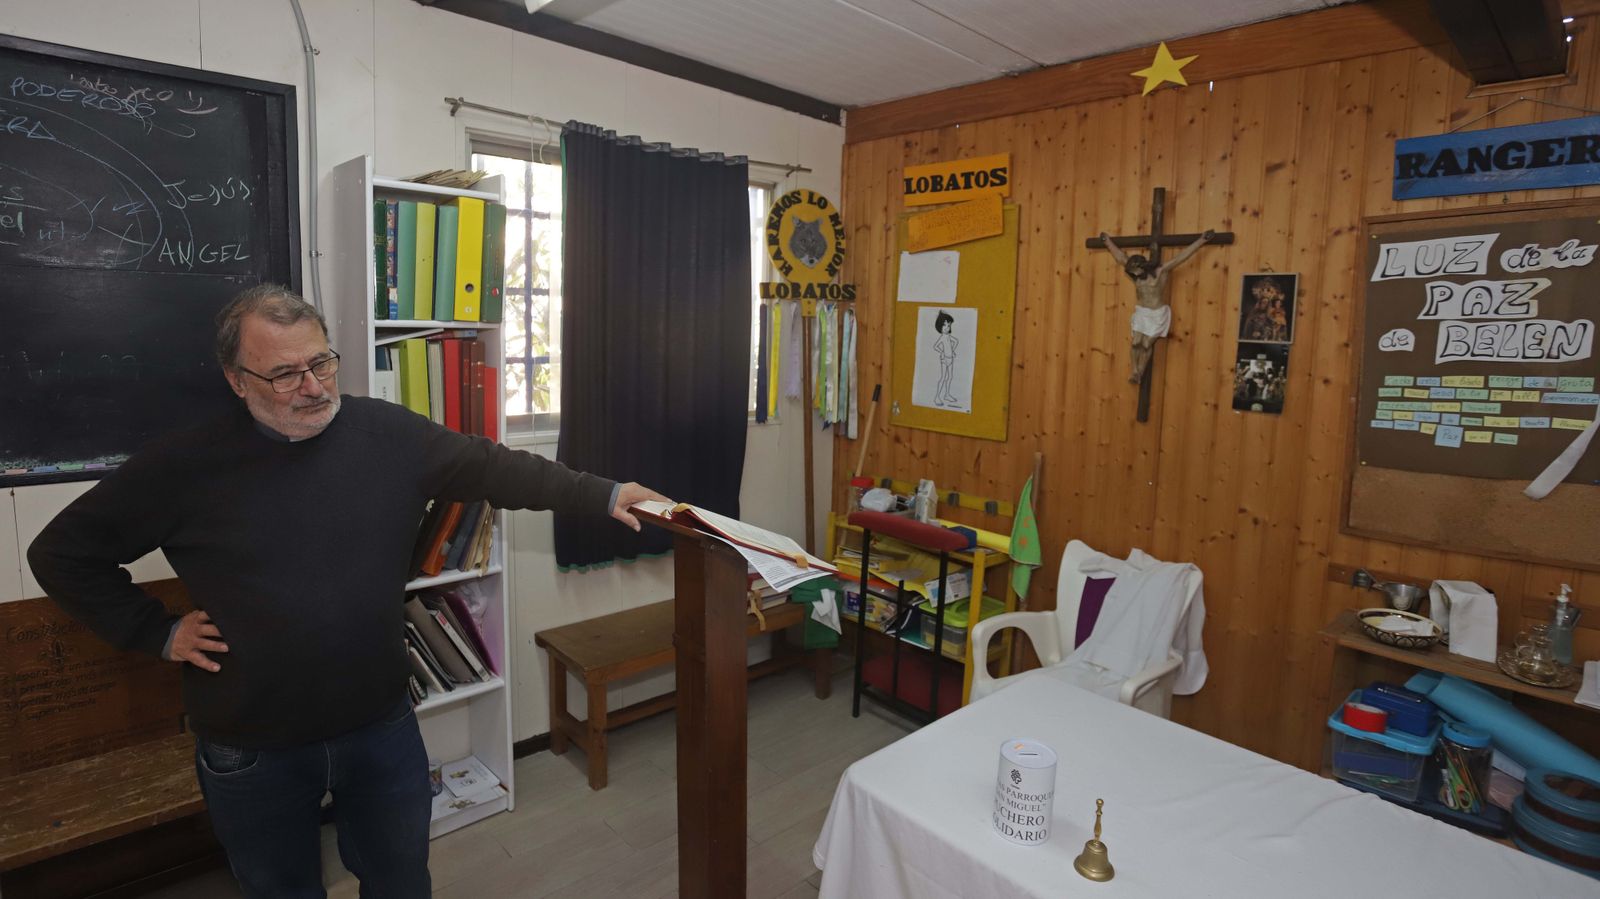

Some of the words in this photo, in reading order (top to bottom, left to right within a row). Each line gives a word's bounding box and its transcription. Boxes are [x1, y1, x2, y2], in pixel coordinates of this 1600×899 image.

[904, 167, 1008, 195] LOBATOS
[767, 190, 802, 277] HAREMOS
[807, 191, 828, 209] LO
[825, 212, 846, 277] MEJOR
[158, 238, 250, 271] ANGEL
[1380, 240, 1485, 278] LUZ
[1507, 246, 1541, 269] de
[1553, 241, 1586, 261] la
[760, 282, 857, 300] LOBATOS
[1423, 282, 1539, 317] PAZ
[1380, 331, 1410, 348] de
[1440, 323, 1588, 360] BELEN
